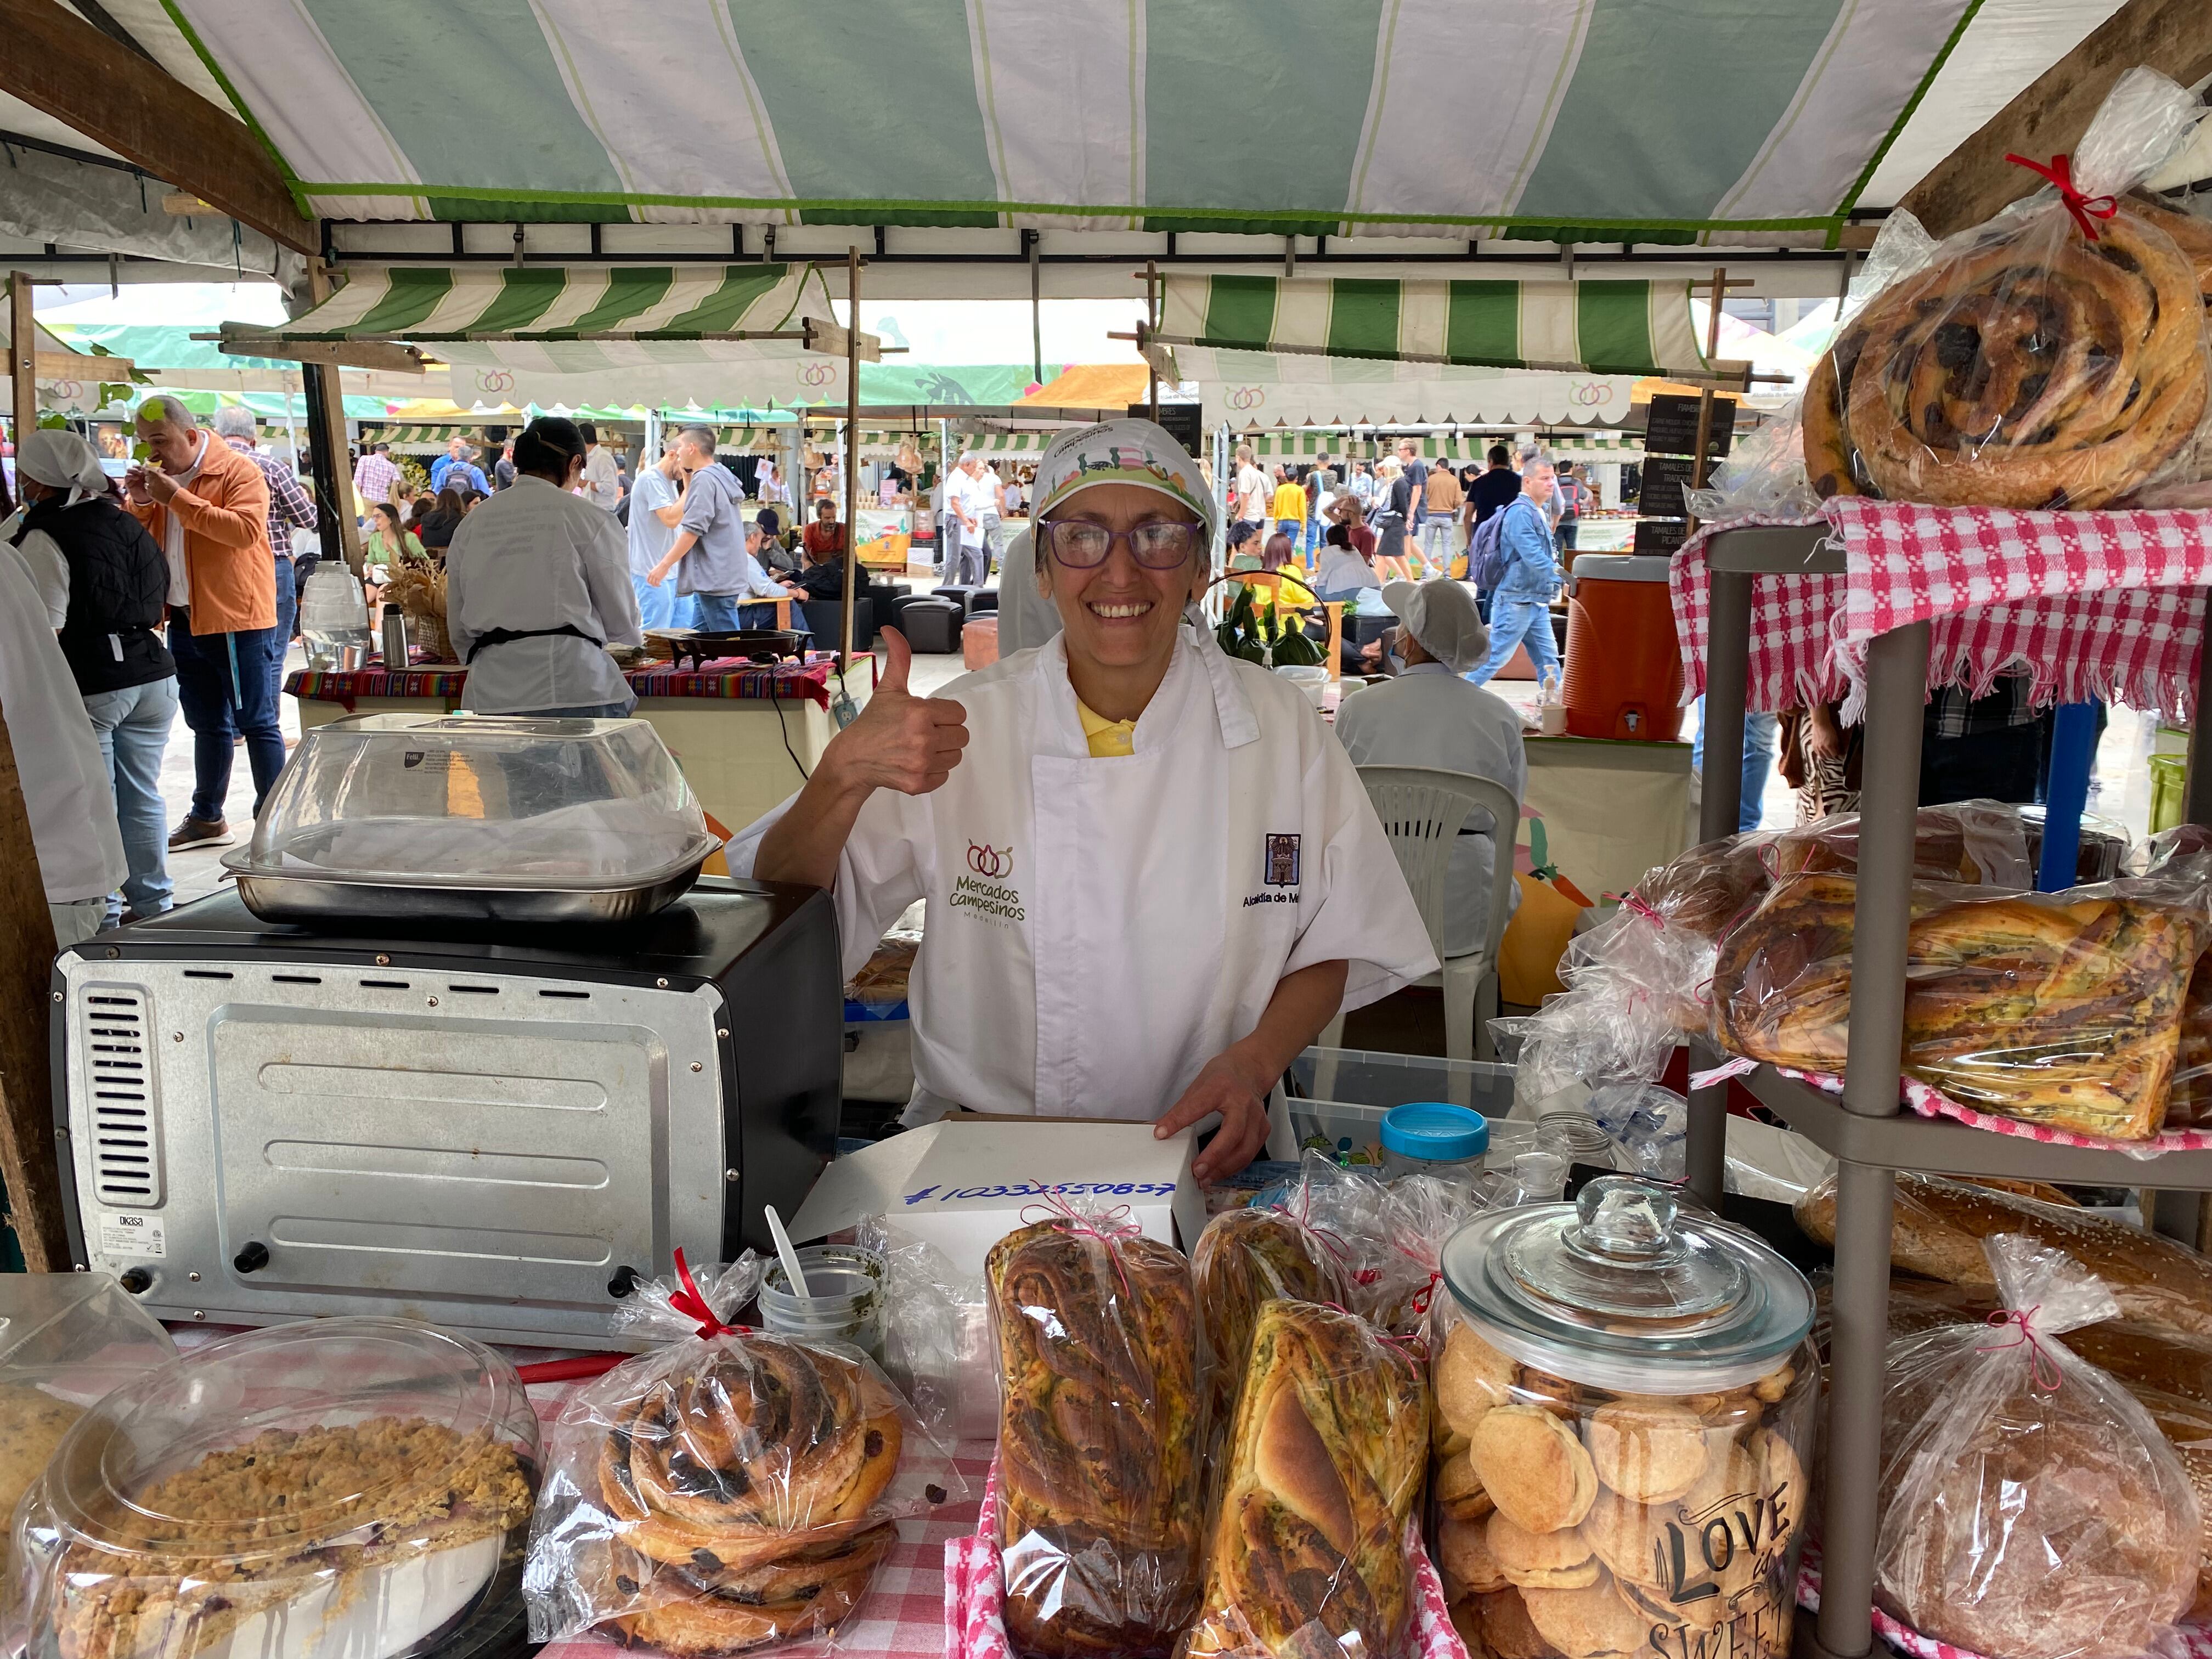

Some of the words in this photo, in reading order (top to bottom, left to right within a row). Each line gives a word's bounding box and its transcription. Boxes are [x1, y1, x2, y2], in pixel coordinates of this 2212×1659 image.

[956, 875, 1019, 904] Mercados
[1243, 892, 1272, 908] Alcaldía
[1274, 893, 1286, 903] de
[950, 893, 1025, 921] Campesinos
[1664, 1481, 1790, 1603] LOVE
[1753, 1548, 1773, 1580] is
